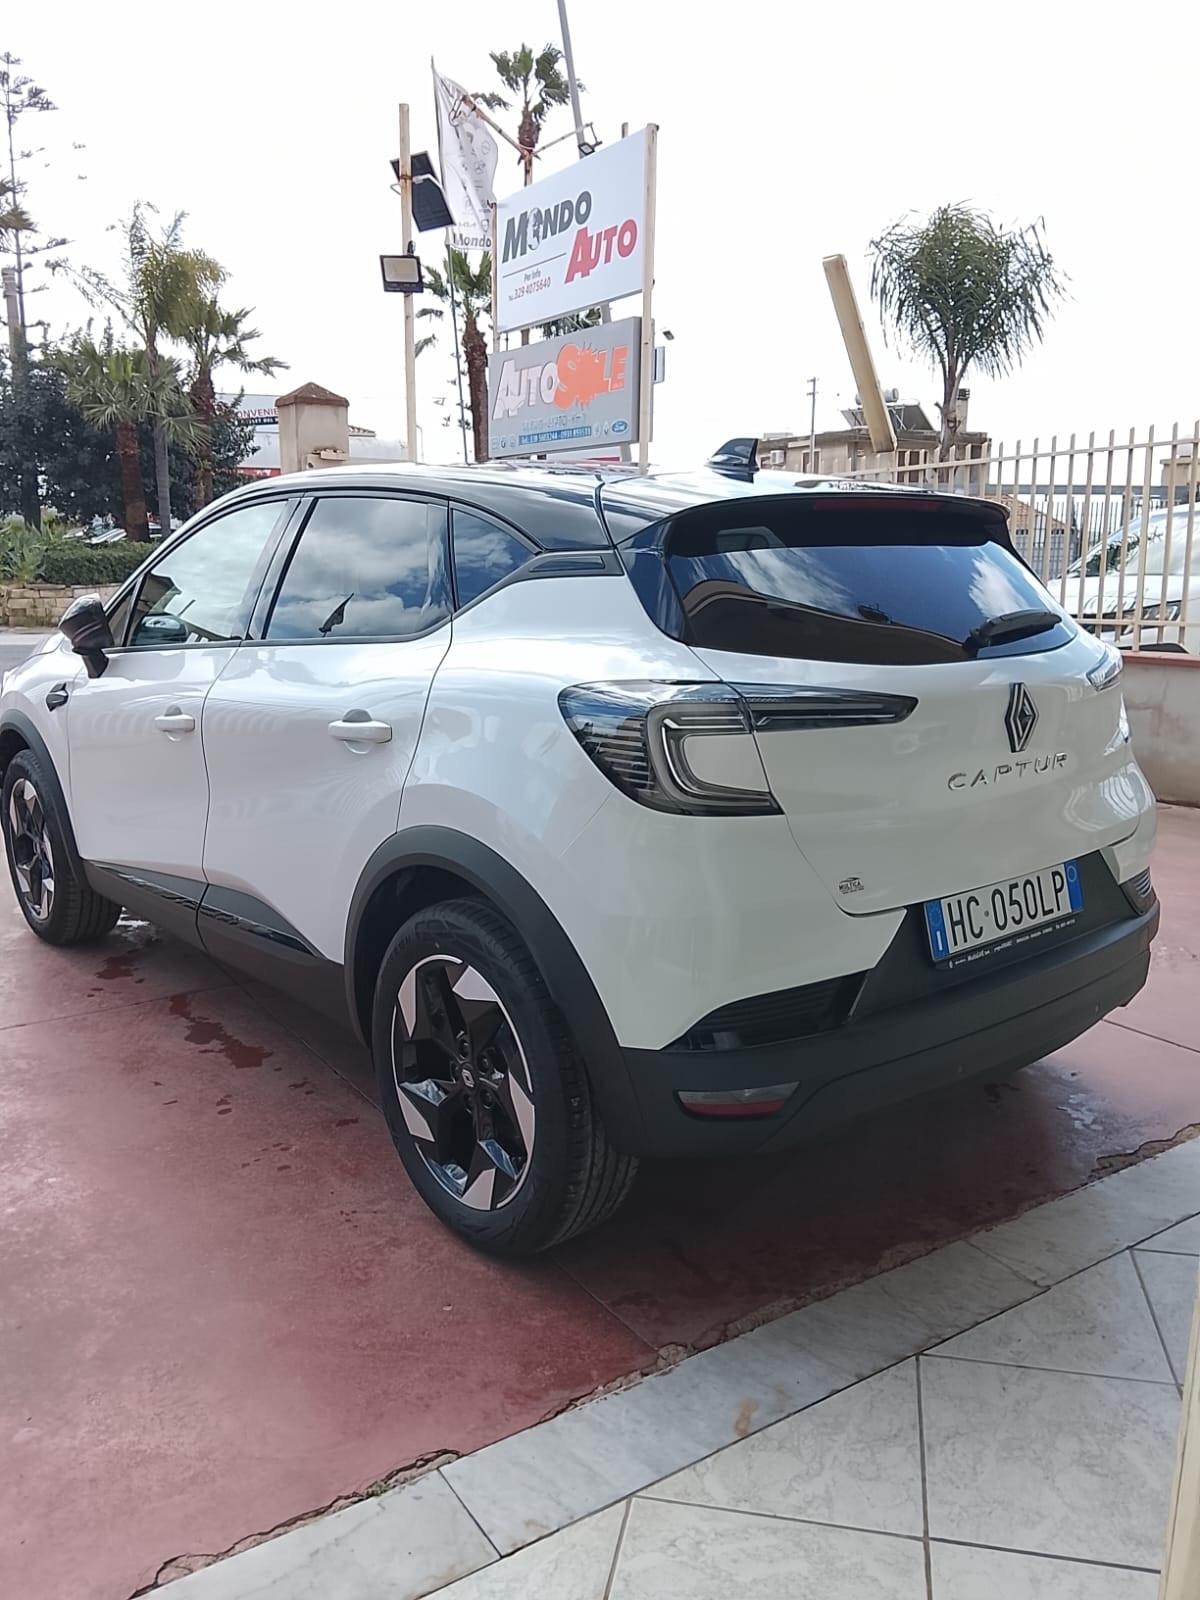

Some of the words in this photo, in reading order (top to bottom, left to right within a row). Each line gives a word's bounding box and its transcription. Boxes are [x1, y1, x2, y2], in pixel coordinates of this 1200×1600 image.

[502, 190, 592, 264] MONDO
[564, 219, 638, 284] AUTO
[947, 752, 1068, 791] CAPTUR
[947, 896, 984, 947] HC
[991, 870, 1065, 931] 050LP
